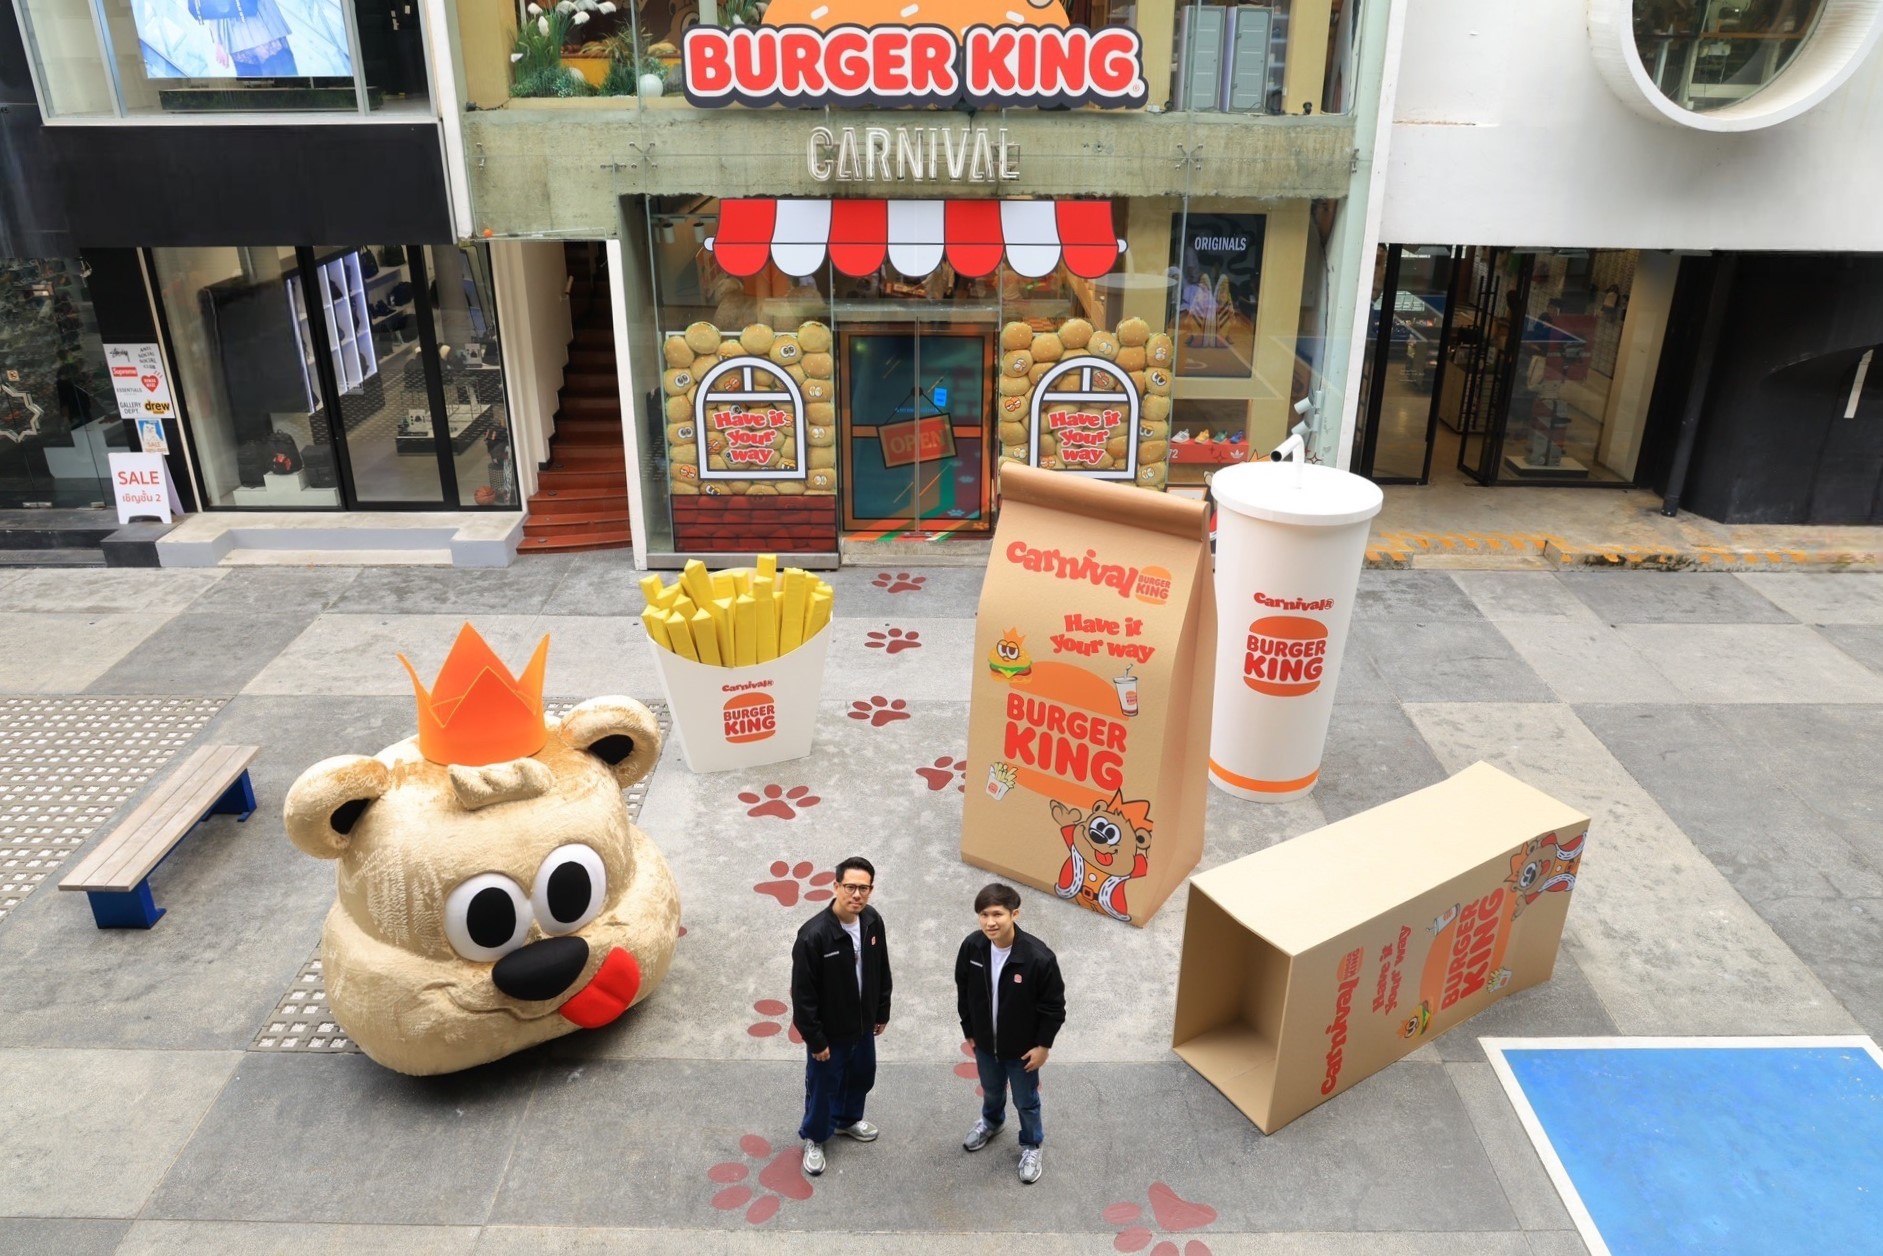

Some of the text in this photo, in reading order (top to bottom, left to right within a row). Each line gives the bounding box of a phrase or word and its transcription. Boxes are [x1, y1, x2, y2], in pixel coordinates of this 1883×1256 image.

[688, 31, 958, 94] BURGER
[807, 126, 1021, 183] CARNIVAL
[1194, 237, 1247, 251] ORIGINALS
[145, 400, 170, 411] drew
[713, 410, 786, 430] Have it
[1049, 410, 1121, 430] Have it
[726, 429, 777, 447] your
[889, 429, 947, 454] OPEN
[1060, 429, 1110, 447] your
[730, 448, 775, 465] way
[1063, 448, 1106, 465] way
[117, 471, 160, 485] SALE
[122, 490, 162, 504] เชิญชั้น 2
[1136, 582, 1170, 600] KING
[1138, 574, 1171, 589] BURGER
[1064, 613, 1144, 638] Have it
[1050, 633, 1156, 664] your way
[1246, 634, 1327, 659] BURGER
[1243, 651, 1324, 682] KING
[723, 704, 776, 722] BURGER
[1006, 692, 1128, 753] BURGER
[724, 715, 776, 736] KING
[1003, 721, 1124, 791] KING
[1459, 887, 1506, 999] KING
[1441, 898, 1480, 1012] BURGER
[1372, 942, 1393, 1013] Have it
[1384, 925, 1413, 1016] your way
